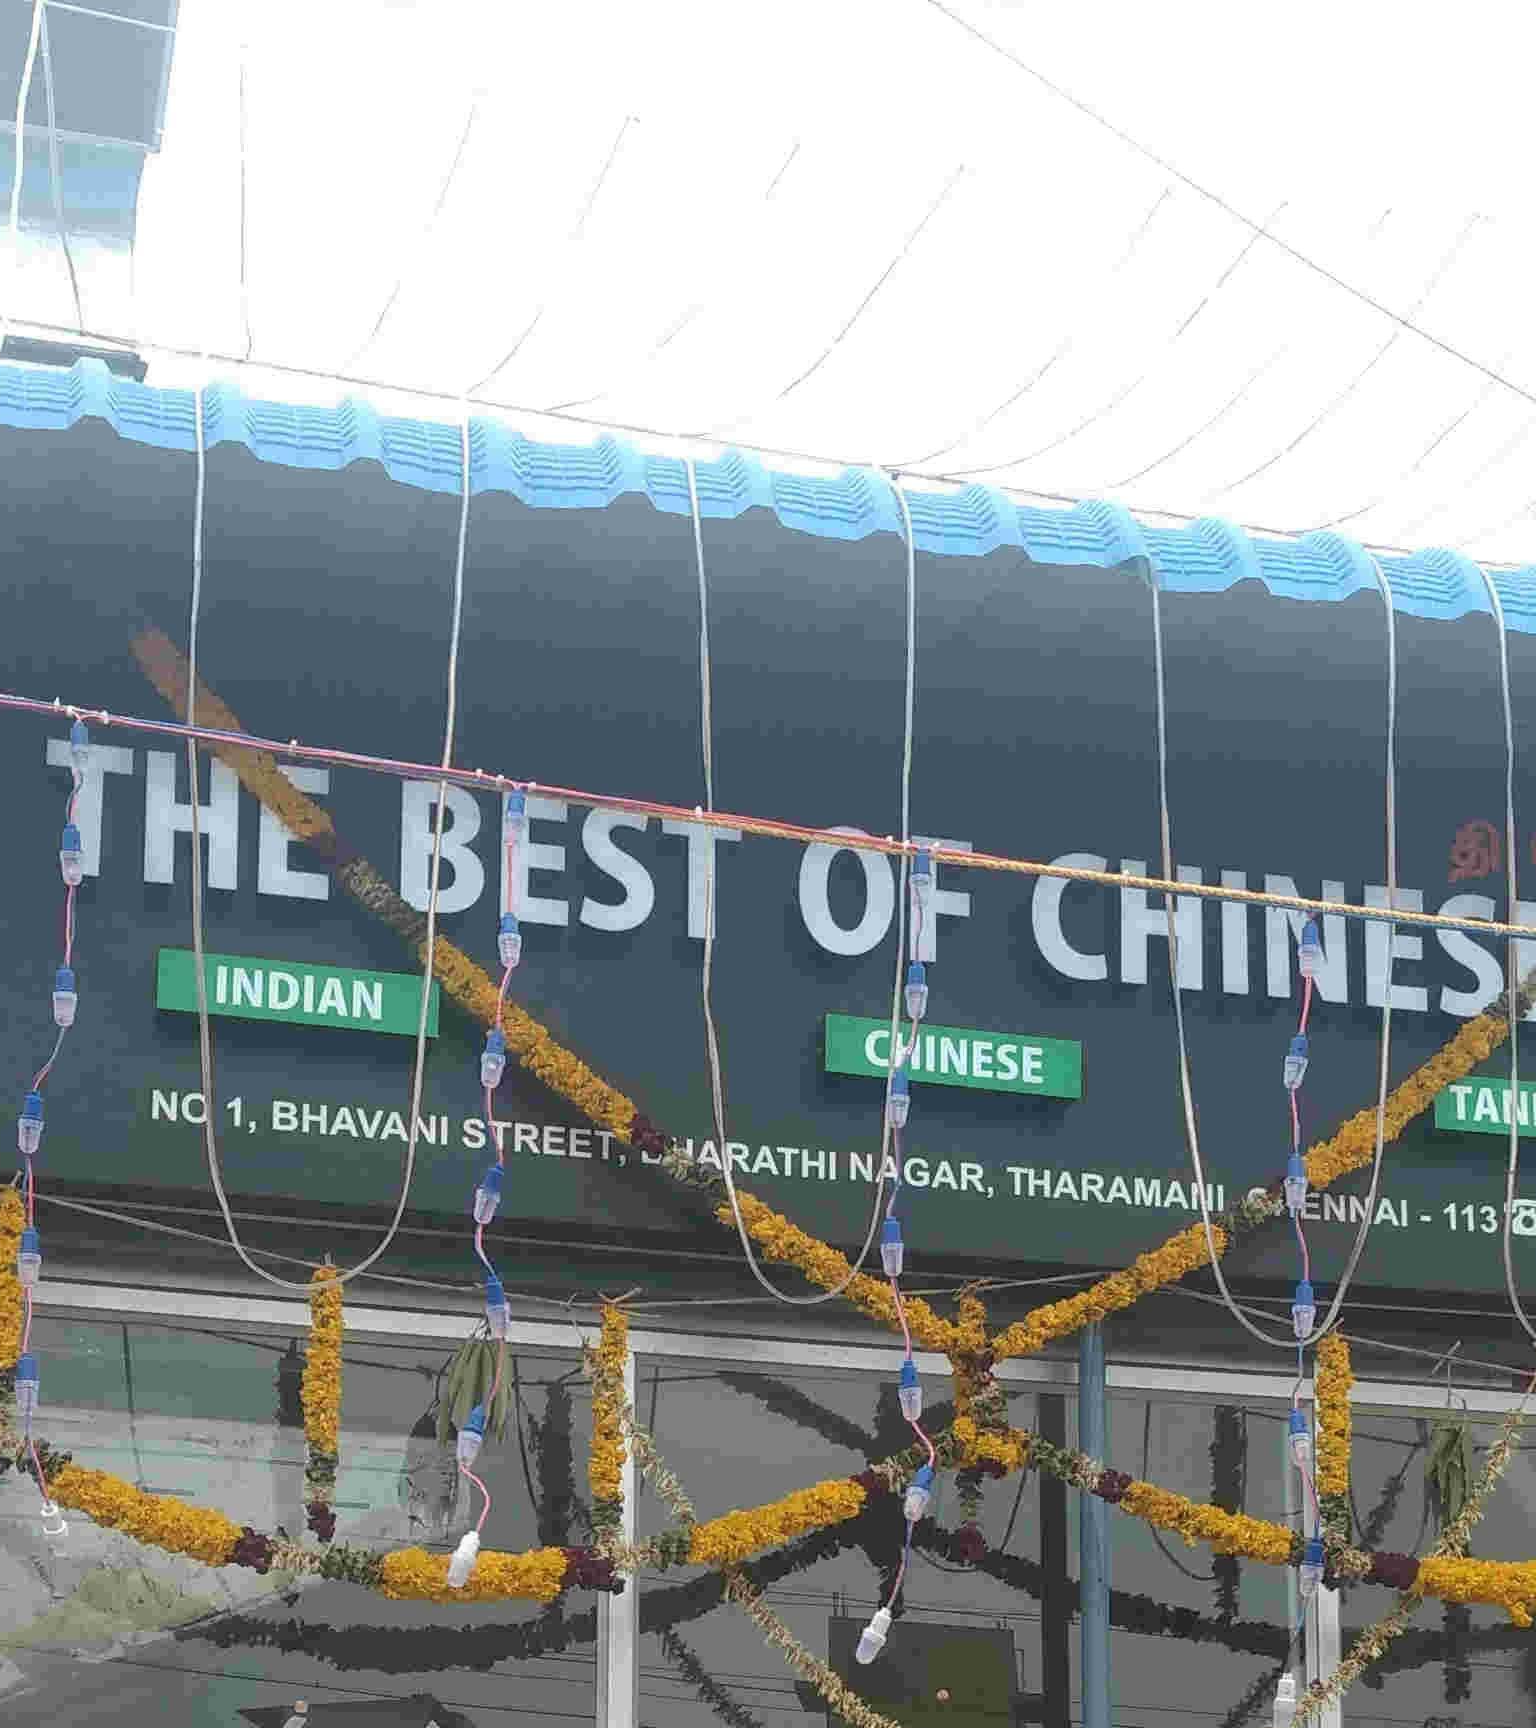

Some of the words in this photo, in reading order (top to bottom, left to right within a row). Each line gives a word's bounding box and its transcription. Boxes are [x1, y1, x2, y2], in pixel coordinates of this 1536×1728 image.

[46, 738, 330, 900] THE
[400, 779, 742, 939] BEST
[798, 826, 973, 962] OF
[216, 965, 383, 1020] INDIAN
[864, 1030, 1043, 1084] CHINESE
[226, 1096, 257, 1134] 1,
[271, 1100, 448, 1145] BHAVANI
[463, 1117, 626, 1167] STREET,
[849, 1151, 995, 1198] NAGAR,
[1005, 1166, 1225, 1212] THARAMANI
[1247, 1187, 1409, 1227] ENNAI
[1443, 1202, 1498, 1234] 113
